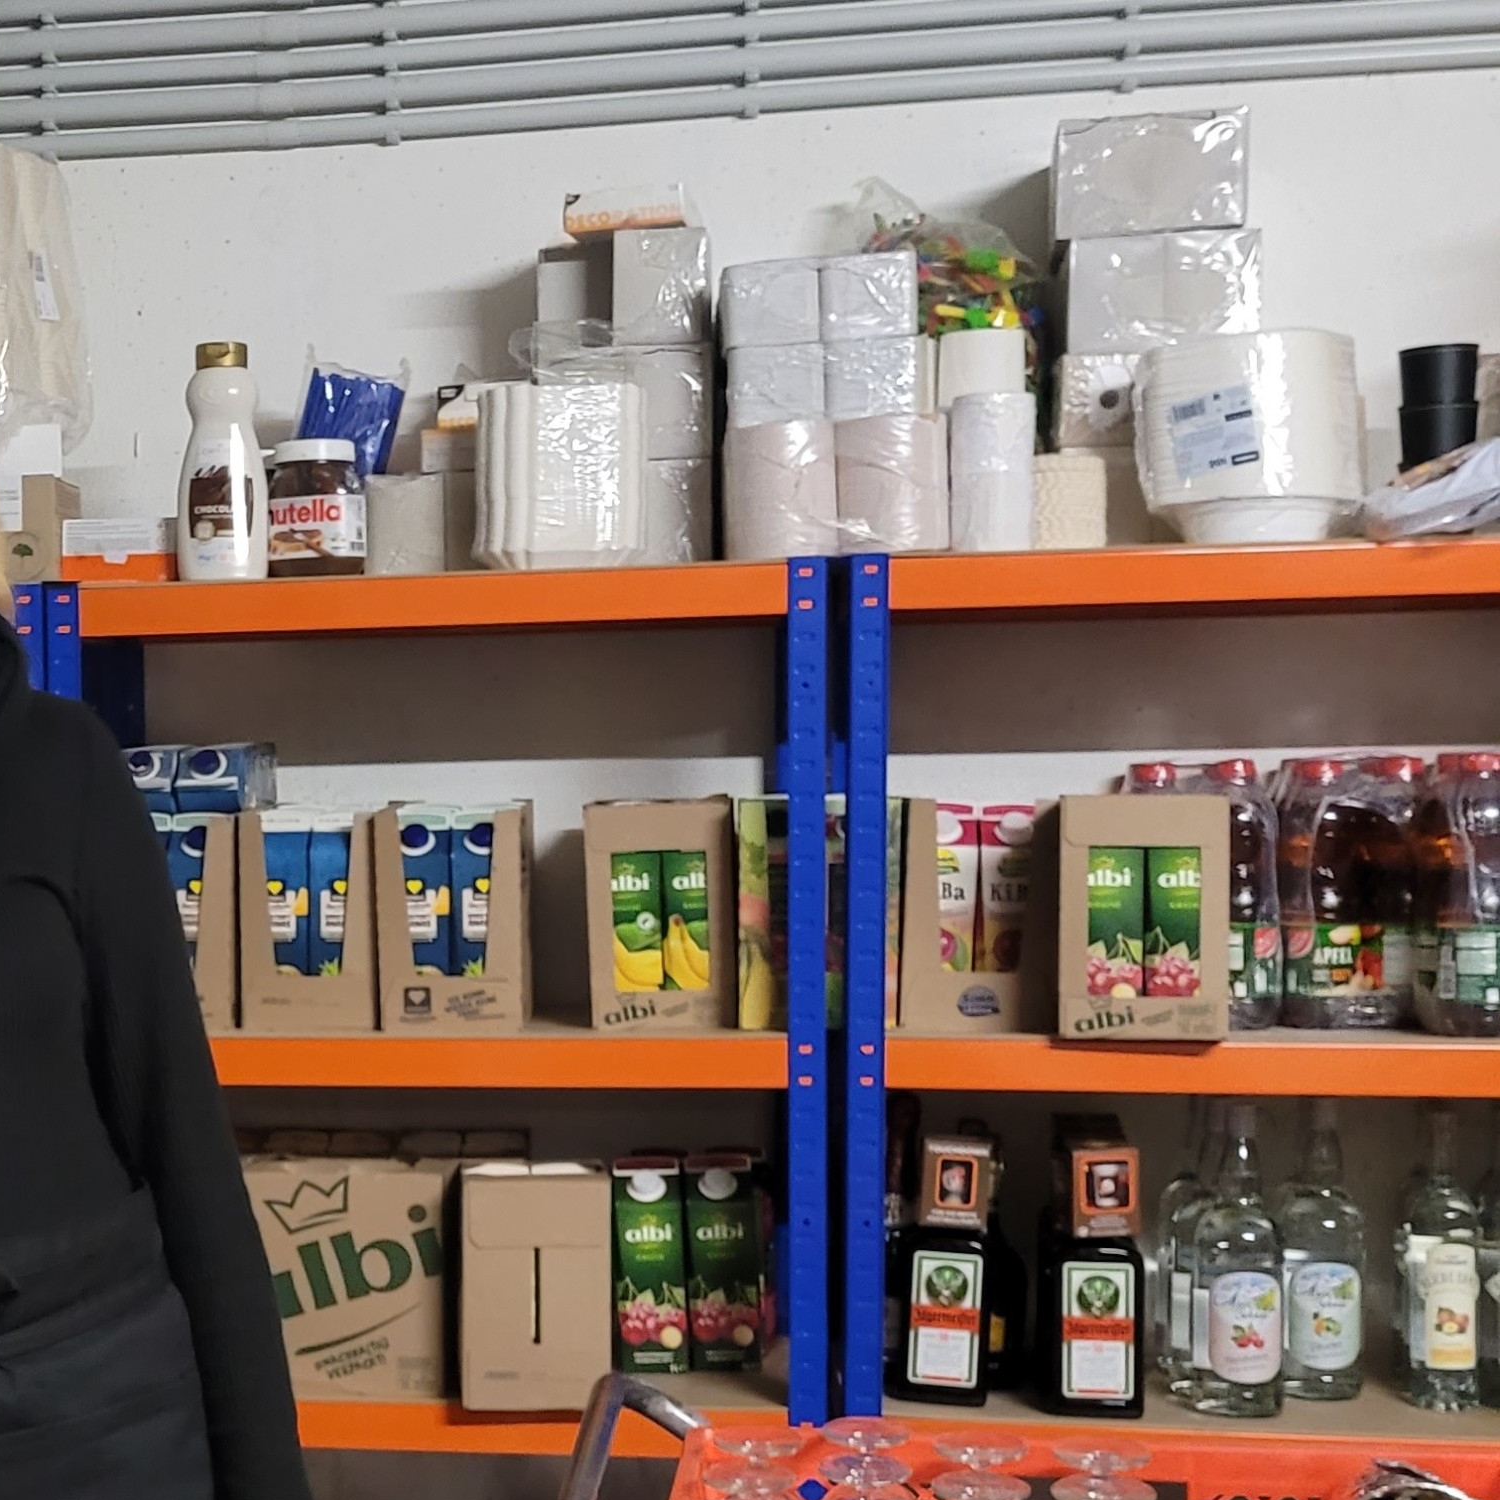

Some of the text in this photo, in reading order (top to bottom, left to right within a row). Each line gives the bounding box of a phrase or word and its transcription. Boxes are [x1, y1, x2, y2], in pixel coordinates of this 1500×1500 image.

[1156, 869, 1202, 888] alb
[603, 1000, 657, 1026] albi
[1073, 1005, 1135, 1033] albi
[624, 1222, 673, 1243] albi
[695, 1222, 746, 1242] albi
